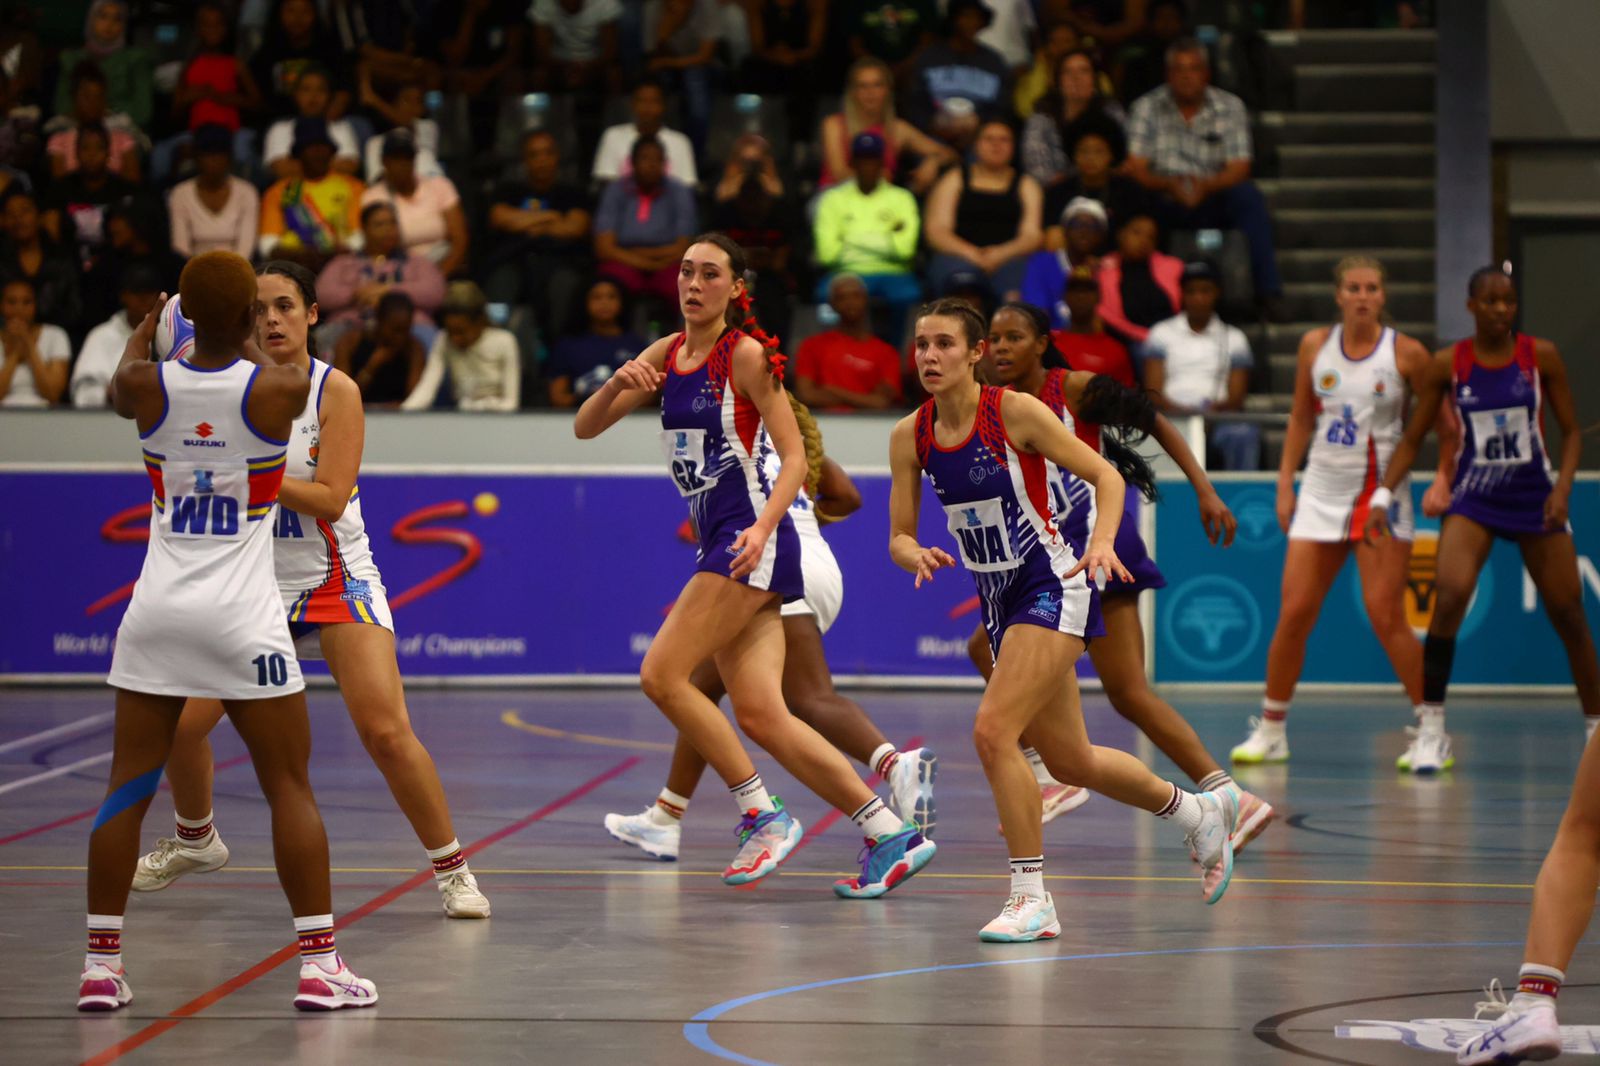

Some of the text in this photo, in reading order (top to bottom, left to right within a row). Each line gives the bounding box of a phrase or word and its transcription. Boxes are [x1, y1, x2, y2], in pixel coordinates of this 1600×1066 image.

[183, 439, 226, 448] SUZUKI
[1327, 419, 1357, 446] GS
[1485, 432, 1521, 460] GK
[171, 495, 239, 535] WD
[956, 524, 1009, 564] WA
[425, 633, 527, 659] Champions
[252, 652, 288, 686] 10
